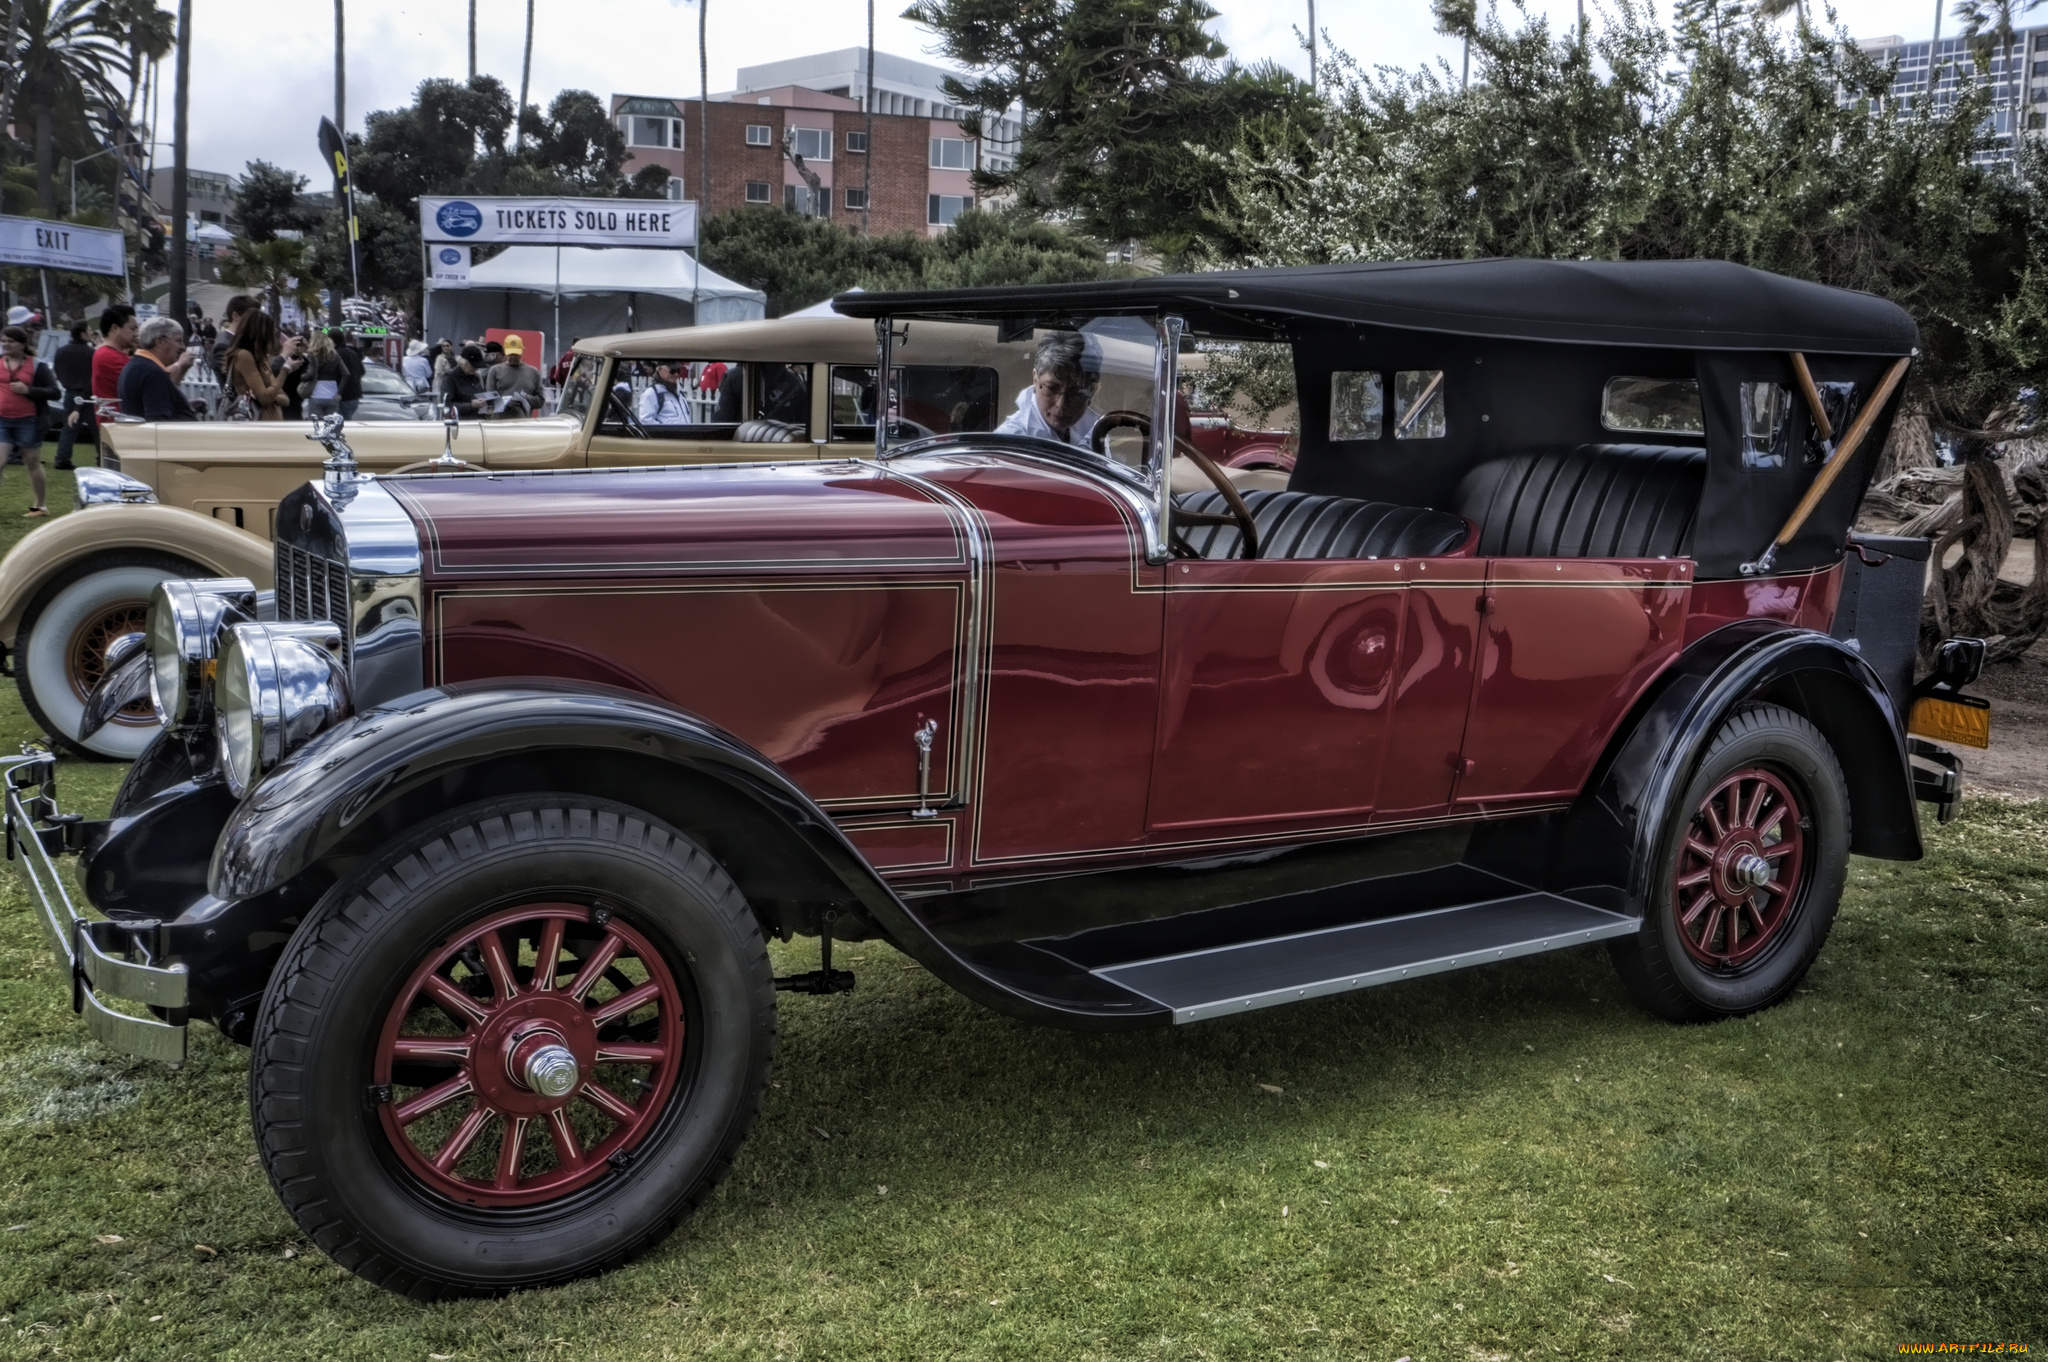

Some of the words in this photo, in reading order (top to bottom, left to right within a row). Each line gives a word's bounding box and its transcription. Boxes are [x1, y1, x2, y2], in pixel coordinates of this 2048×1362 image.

[496, 210, 566, 229] TICKETS
[575, 212, 617, 231] SOLD
[626, 213, 671, 232] HERE
[36, 228, 70, 251] EXIT
